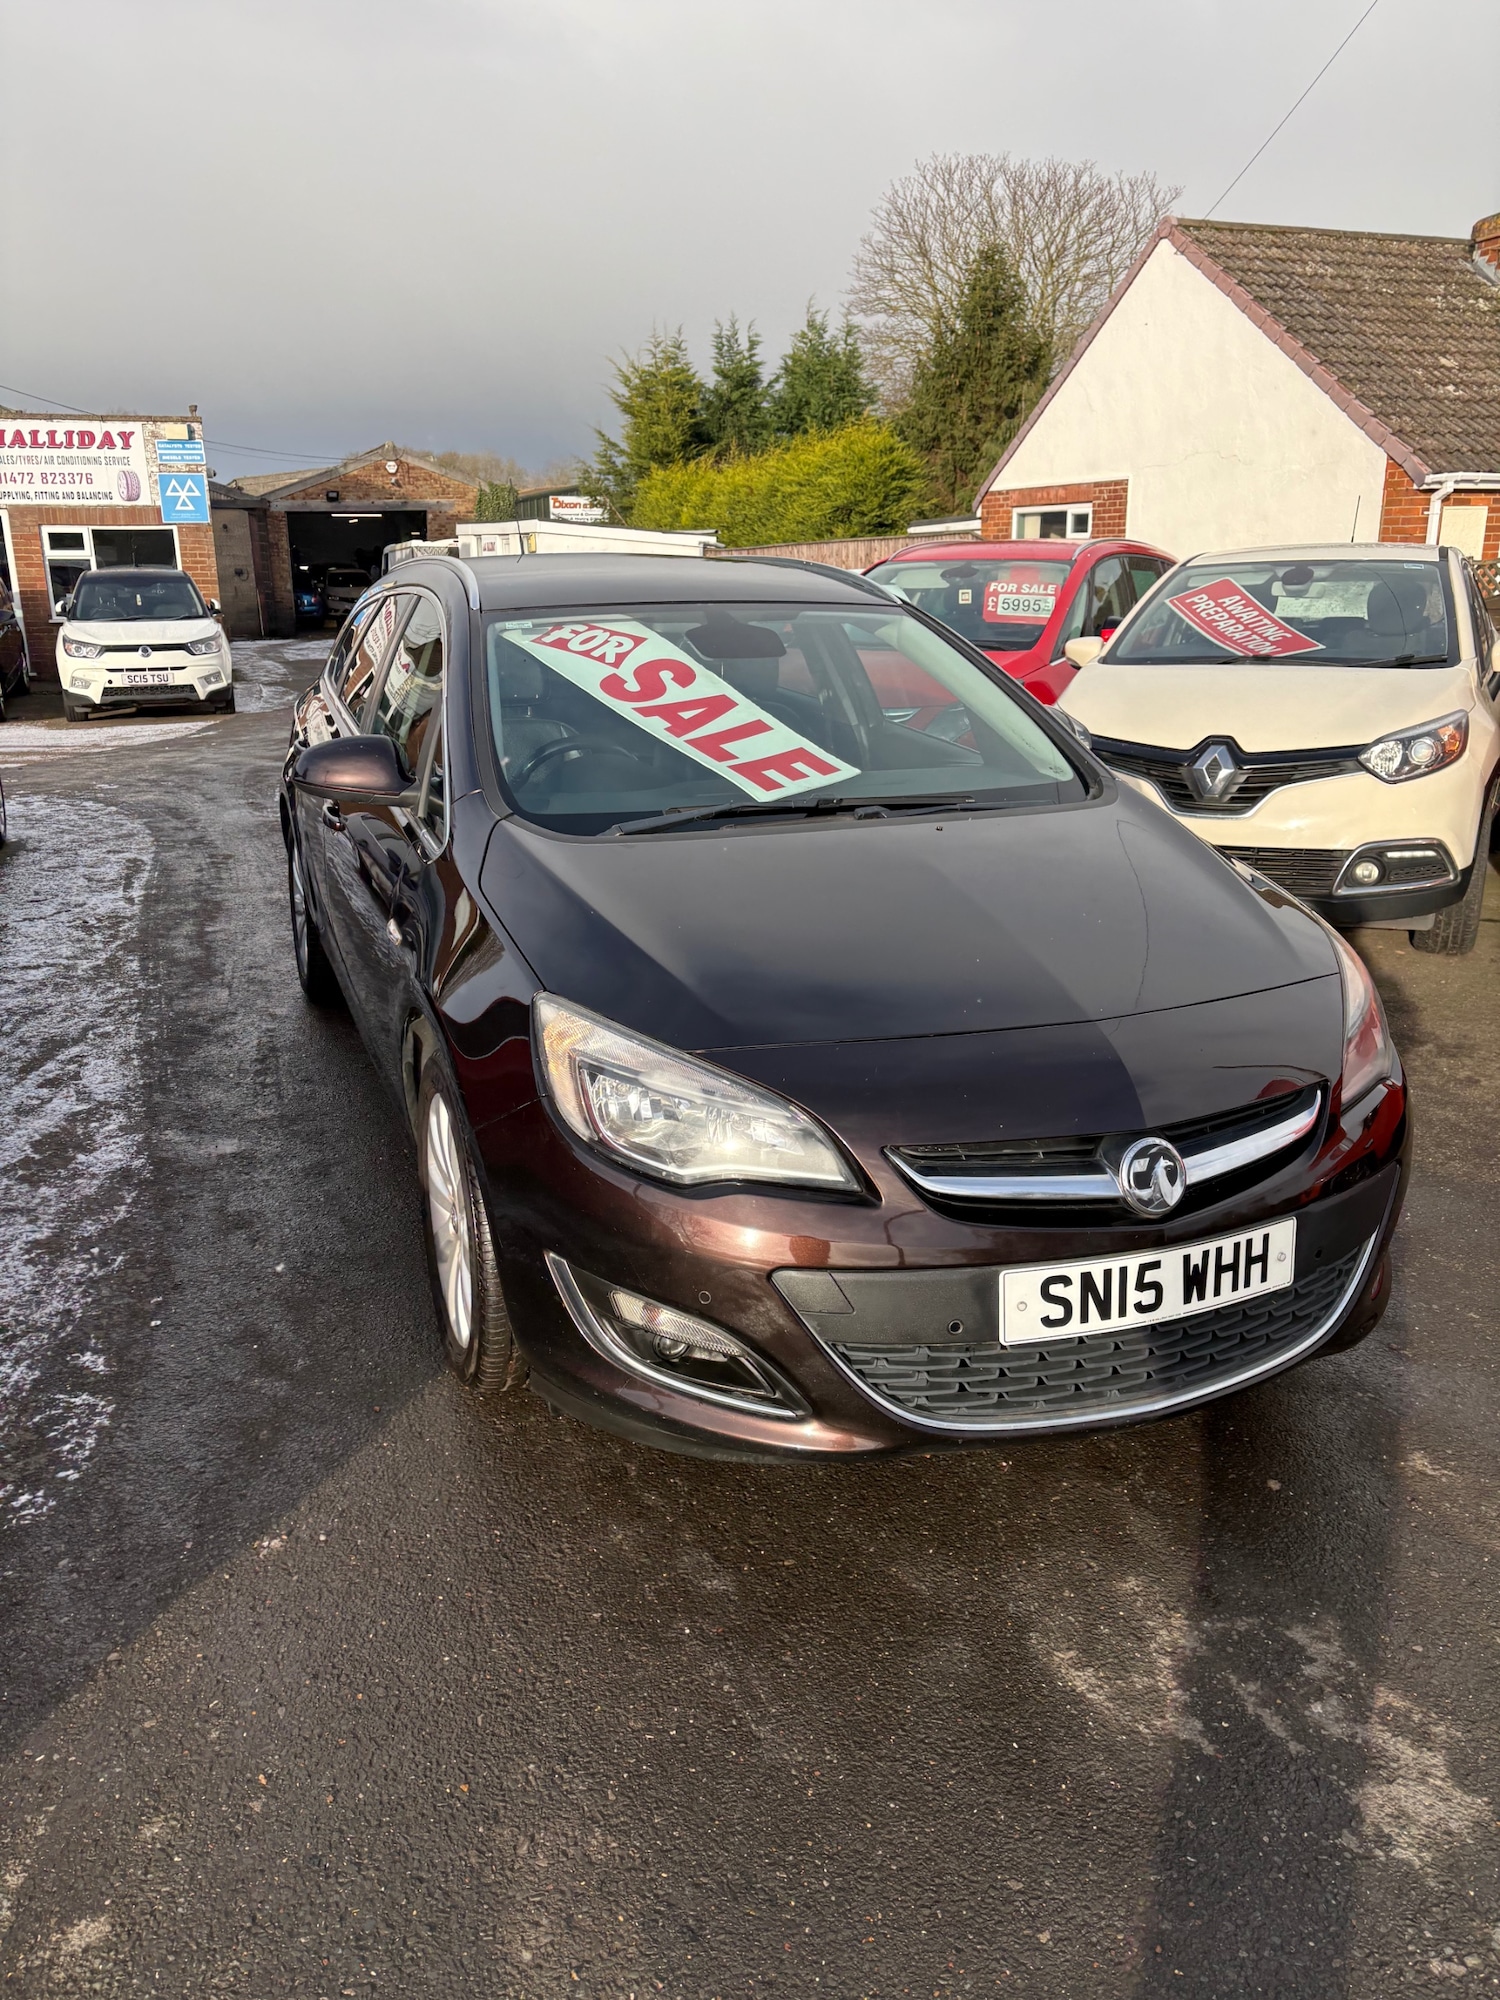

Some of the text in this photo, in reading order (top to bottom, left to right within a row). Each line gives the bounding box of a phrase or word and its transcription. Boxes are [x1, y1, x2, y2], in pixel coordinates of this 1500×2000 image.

[56, 455, 102, 466] CONDITIONING
[103, 455, 131, 466] SERVICE
[40, 472, 94, 485] 823376
[34, 490, 60, 500] FITTING
[62, 490, 75, 500] AND
[76, 490, 113, 500] BALANCING
[989, 582, 1057, 595] FOR SALE
[1185, 593, 1283, 655] PREPARATION
[1217, 594, 1293, 642] AWAITING
[541, 623, 638, 666] FOR
[127, 674, 169, 683] SC15 TSU
[599, 658, 842, 792] SALE
[1040, 1232, 1270, 1329] SN15 WHH
